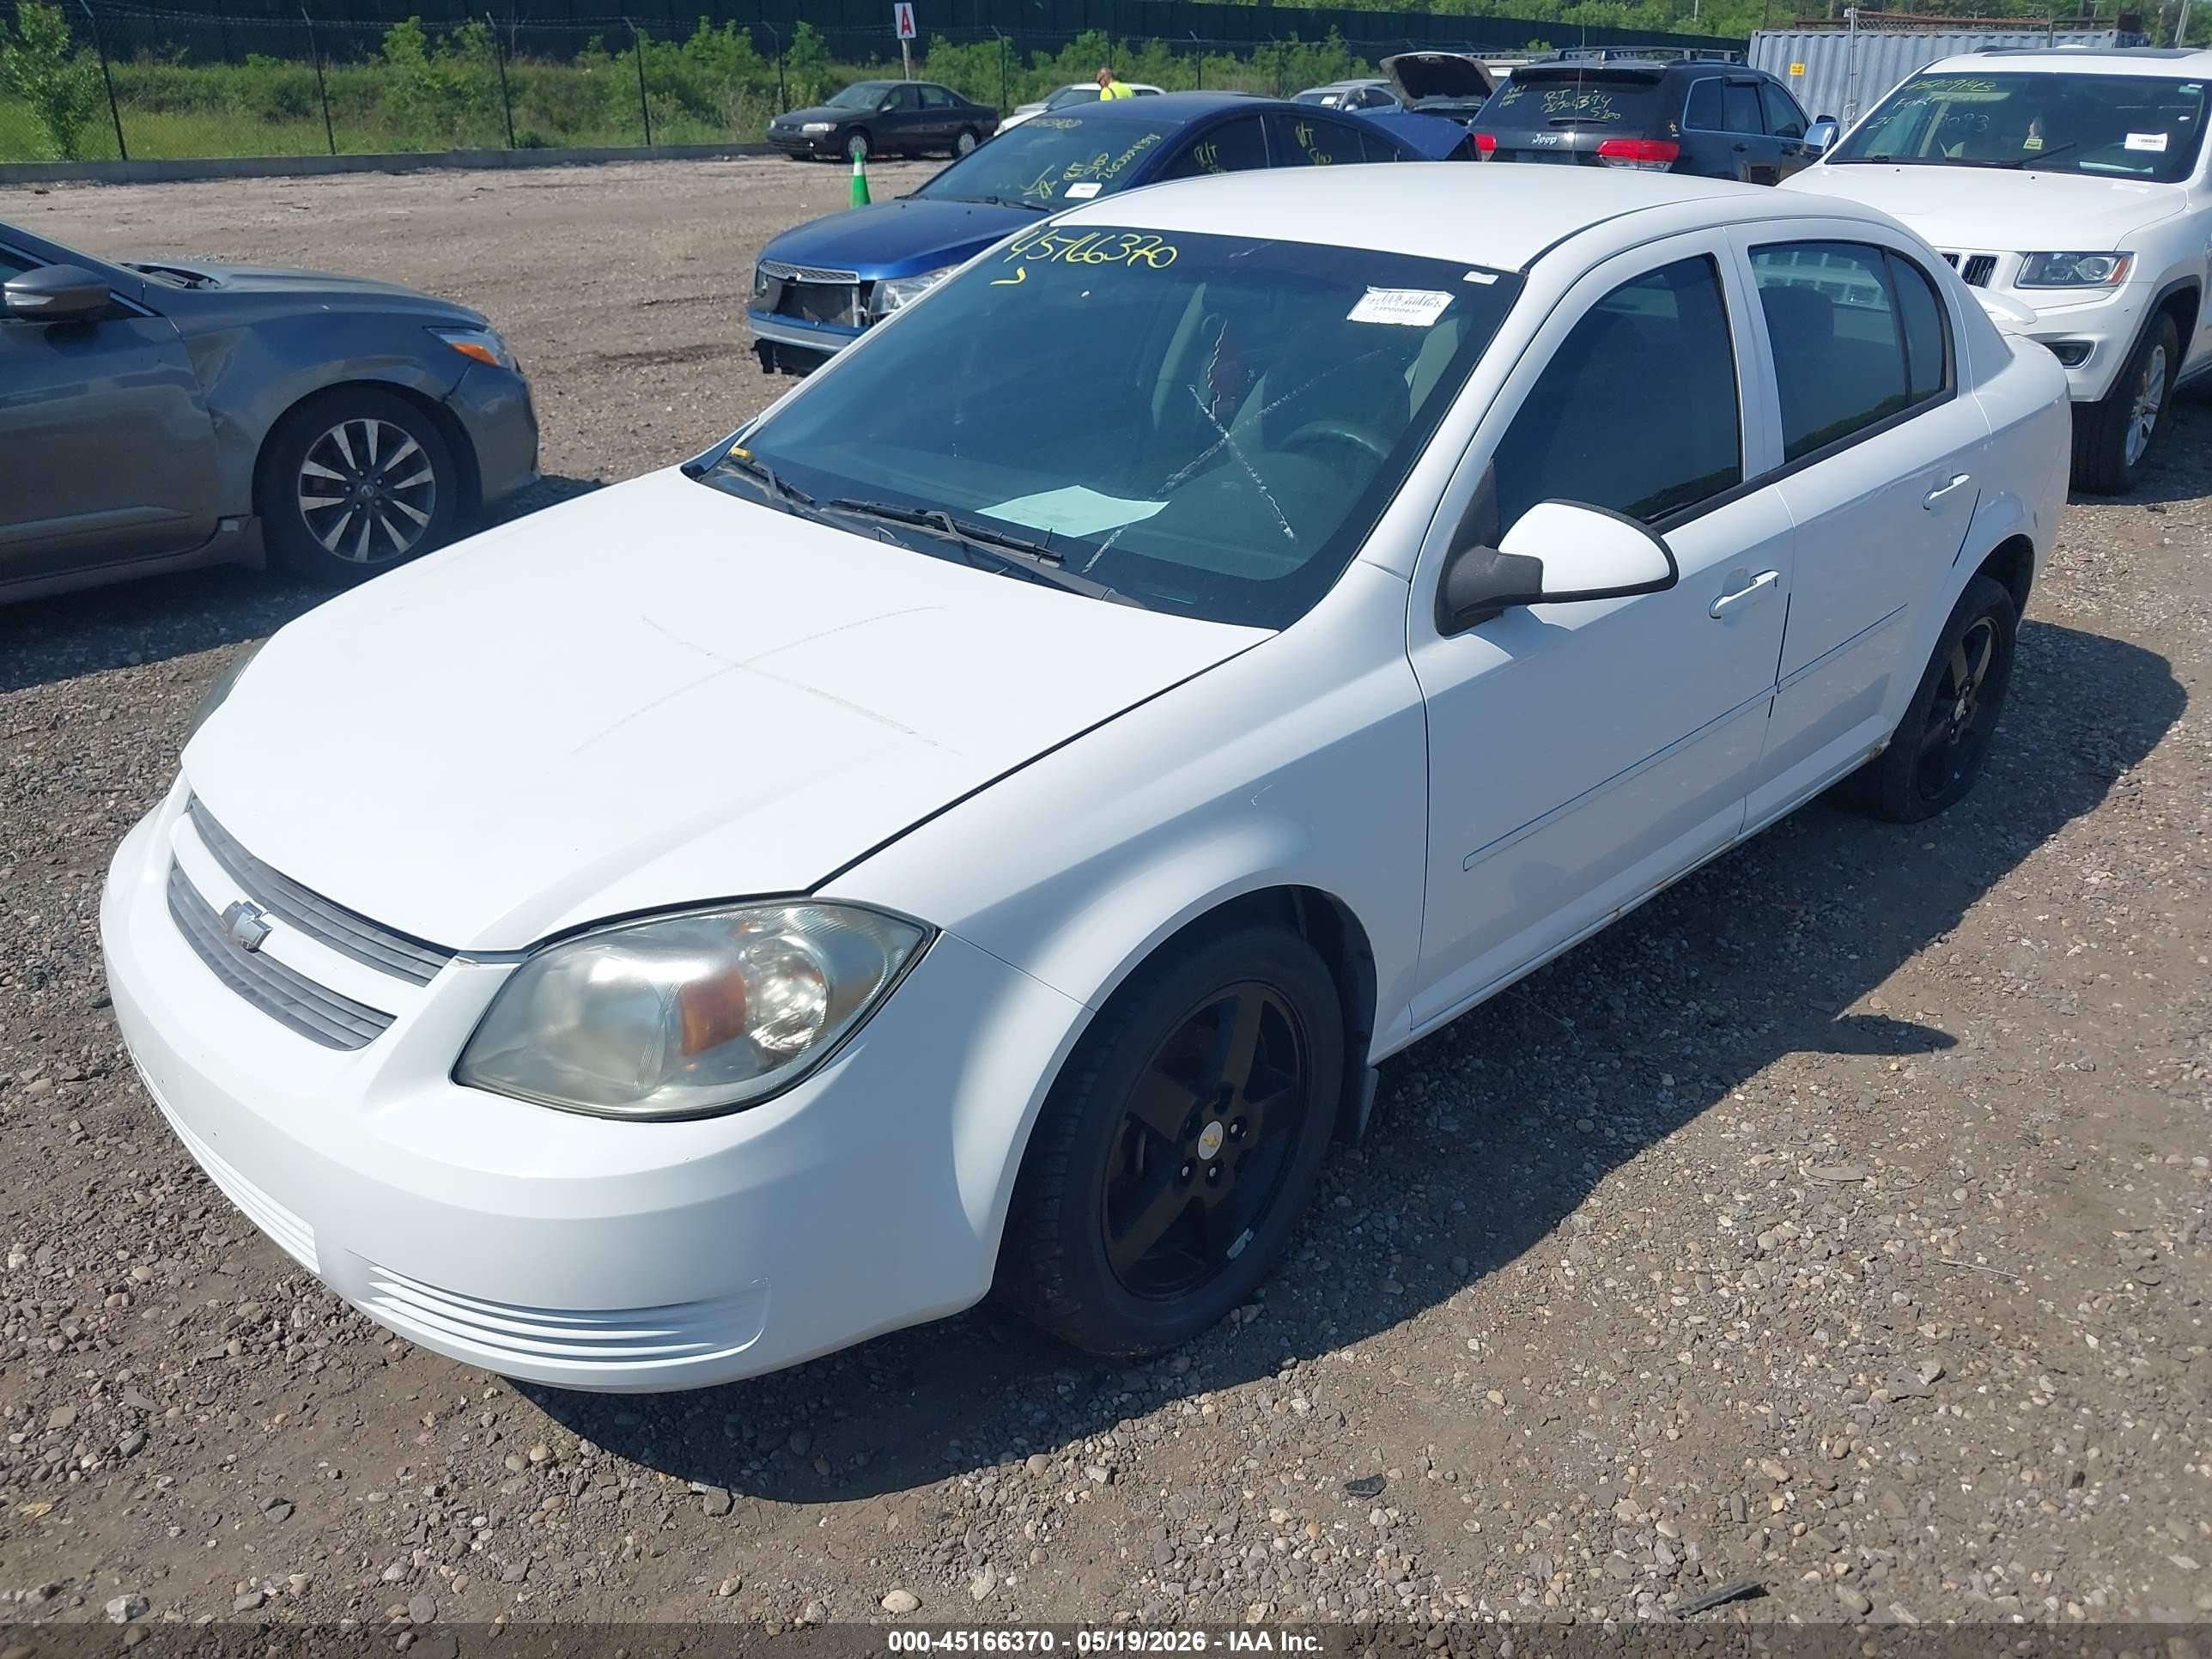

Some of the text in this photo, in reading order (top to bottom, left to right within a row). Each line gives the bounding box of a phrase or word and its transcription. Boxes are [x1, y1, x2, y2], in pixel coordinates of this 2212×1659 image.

[902, 5, 912, 35] A
[1532, 133, 1558, 145] Jeep
[1003, 228, 1177, 268] 45166370
